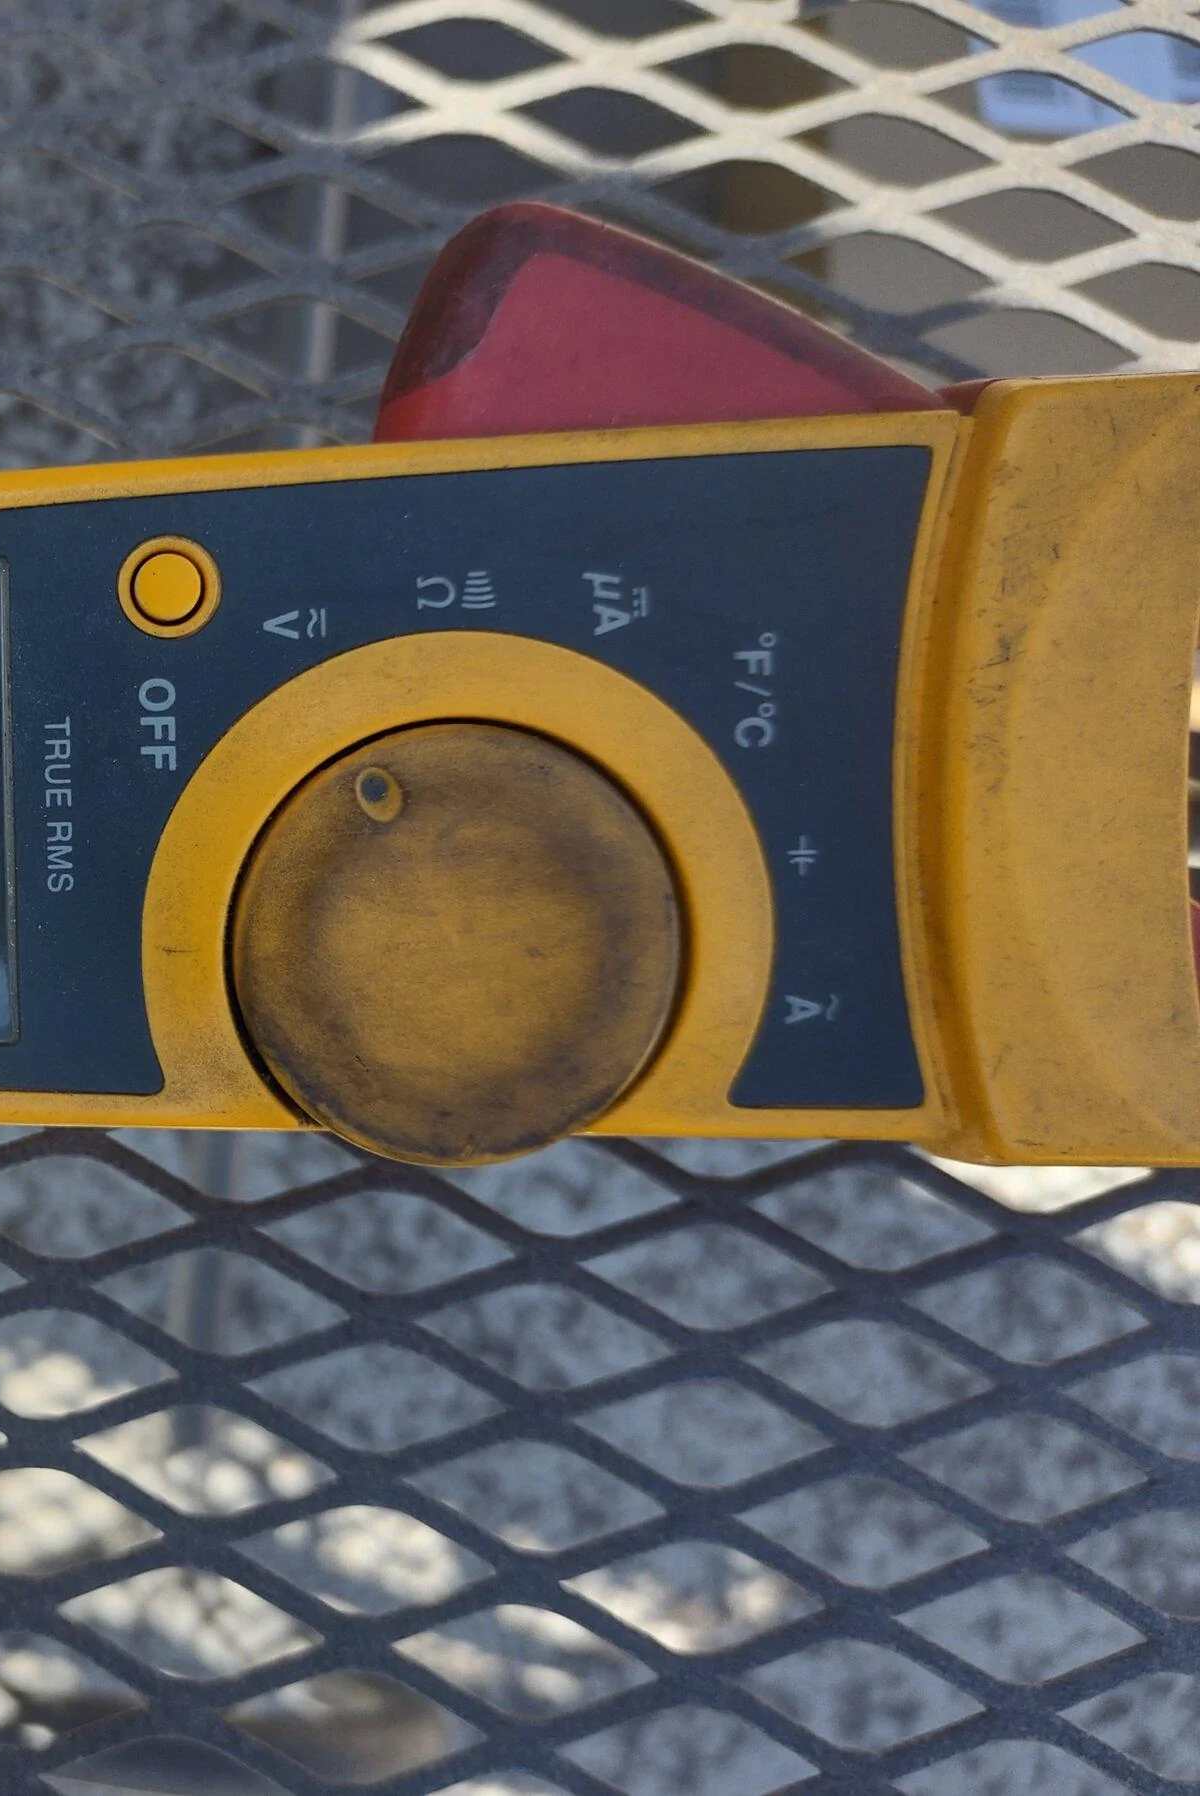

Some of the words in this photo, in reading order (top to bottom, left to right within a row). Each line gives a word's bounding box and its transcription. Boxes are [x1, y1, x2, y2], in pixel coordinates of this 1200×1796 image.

[43, 716, 73, 808] TRUE
[138, 677, 177, 772] OFF
[46, 821, 75, 893] RMS
